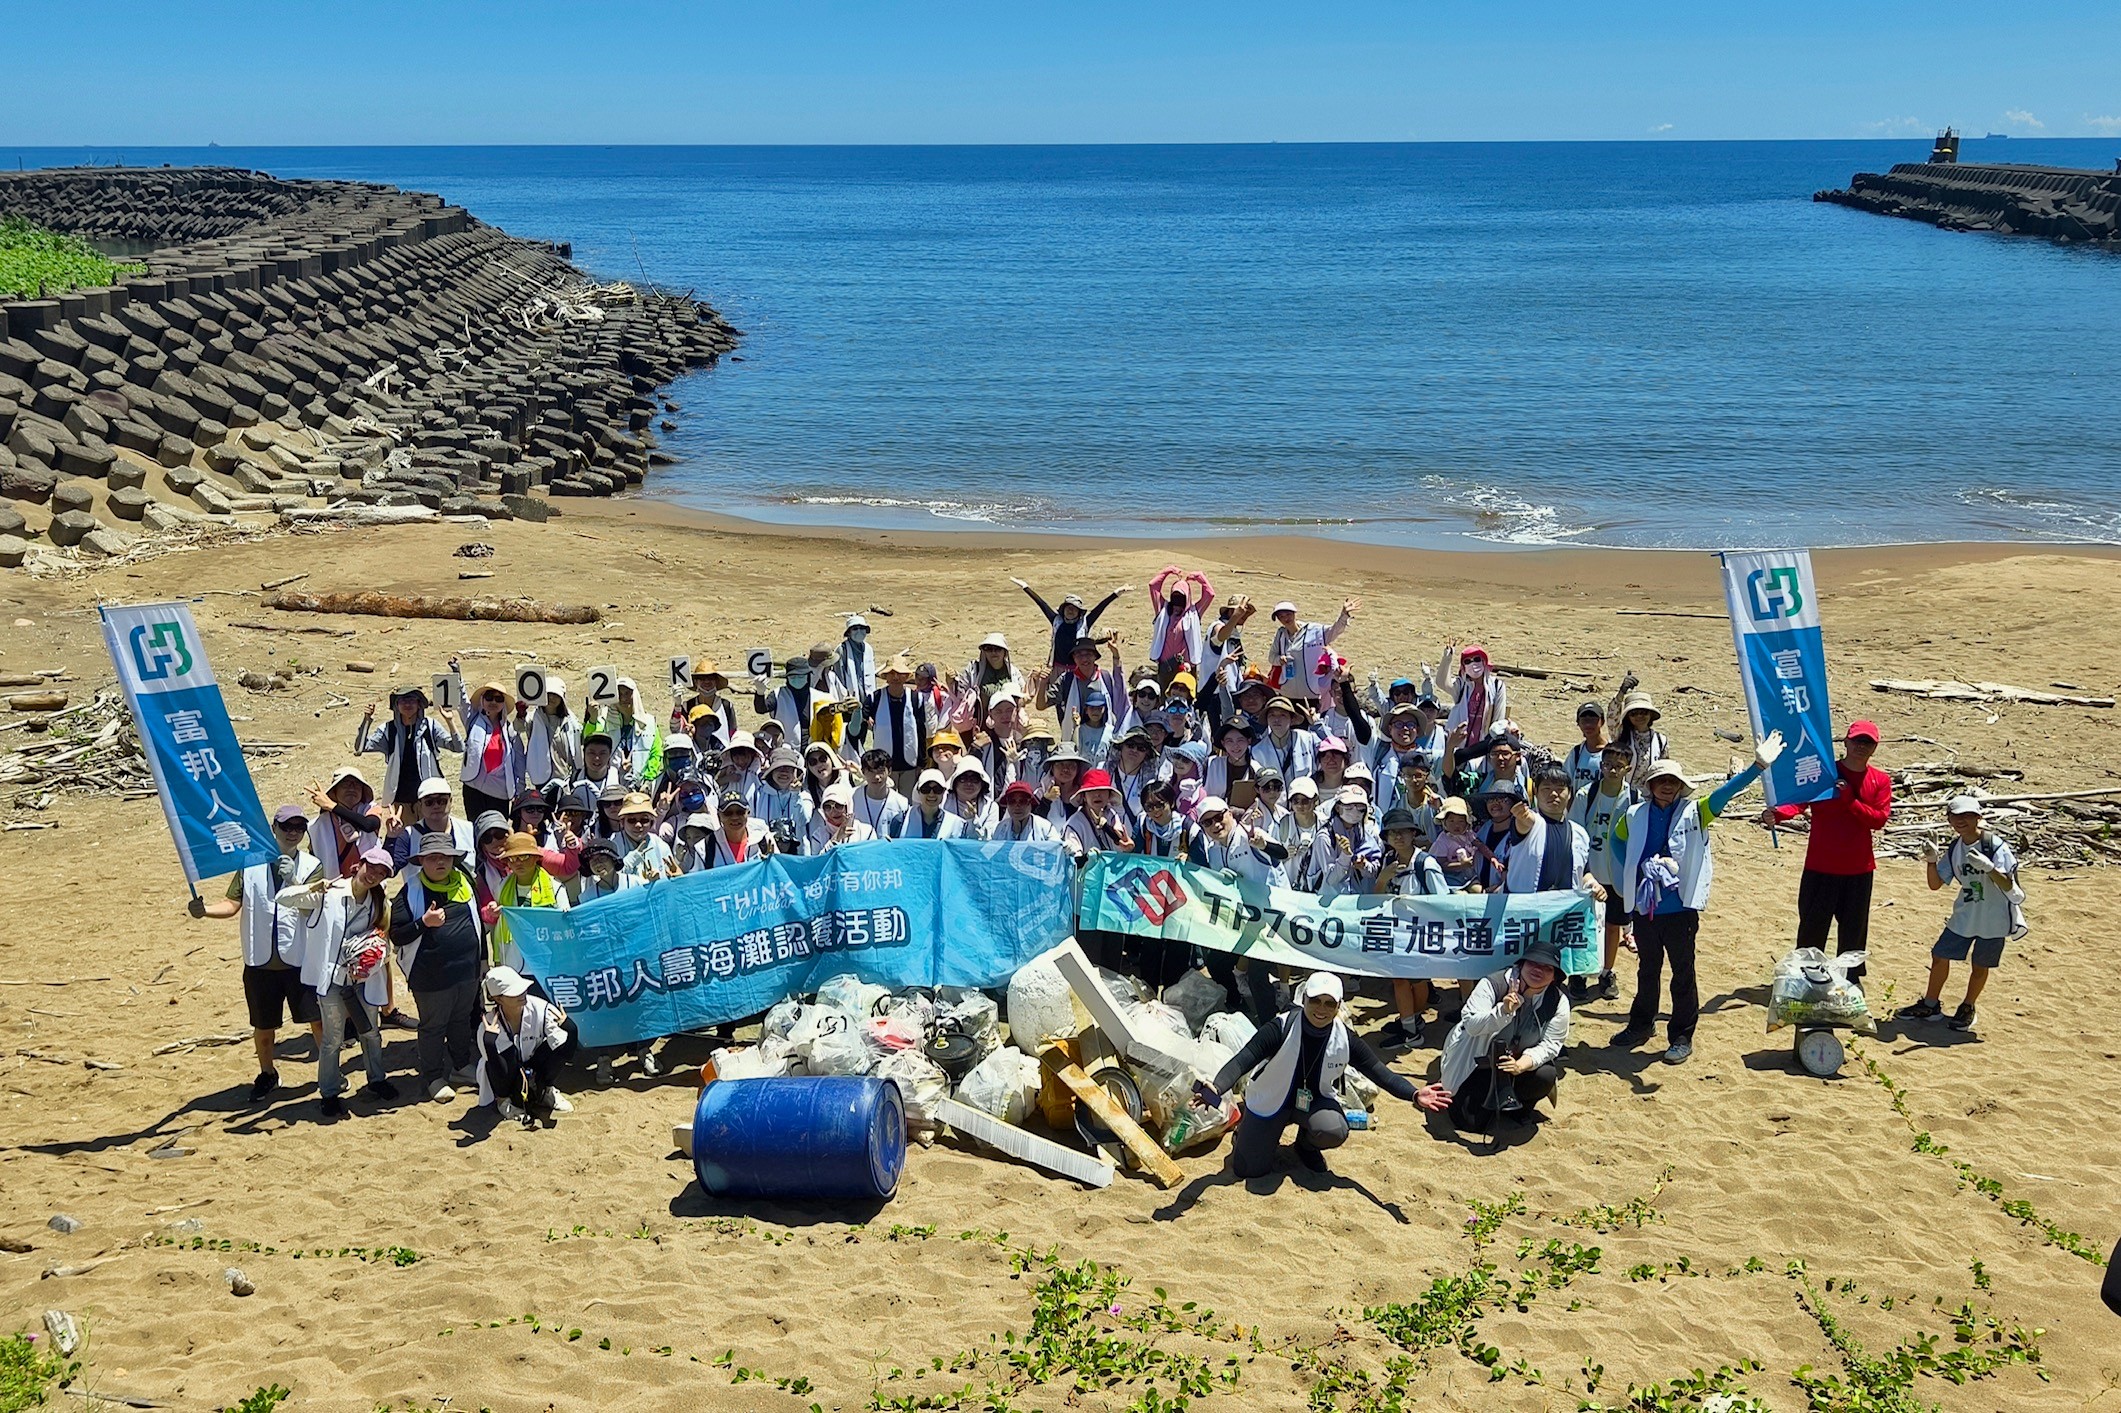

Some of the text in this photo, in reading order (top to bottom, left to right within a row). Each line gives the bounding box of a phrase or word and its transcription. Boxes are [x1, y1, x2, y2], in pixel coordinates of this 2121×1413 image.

[436, 678, 453, 709] 1
[590, 672, 616, 700] 2
[671, 659, 689, 684] K
[747, 652, 773, 677] G
[1771, 648, 1821, 786] 富邦人壽
[164, 709, 251, 855] 富邦人壽
[714, 880, 796, 914] THINK
[802, 868, 904, 901] 海好有你邦
[1203, 890, 1589, 956] TP760 富旭通訊處
[545, 906, 907, 1009] 富邦人壽海灘認養活動
